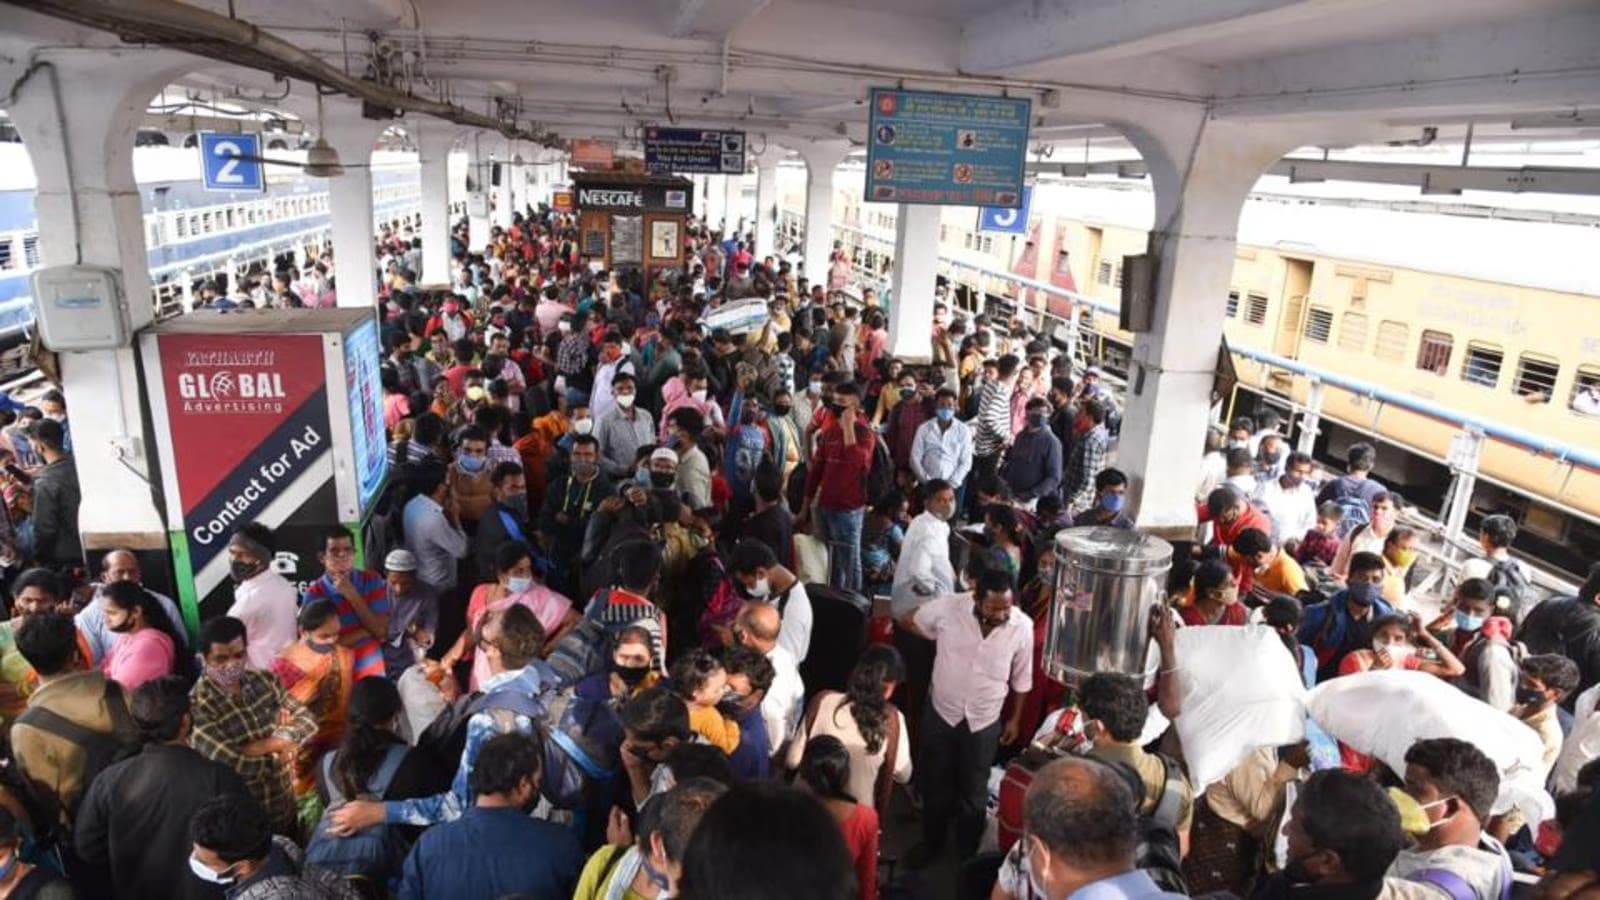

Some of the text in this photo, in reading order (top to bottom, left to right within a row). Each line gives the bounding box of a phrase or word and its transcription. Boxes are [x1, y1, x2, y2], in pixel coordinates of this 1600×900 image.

[213, 141, 244, 184] 2
[178, 371, 287, 401] GLOBAL
[184, 401, 283, 413] Advertising
[193, 425, 321, 544] Contact for Ad
